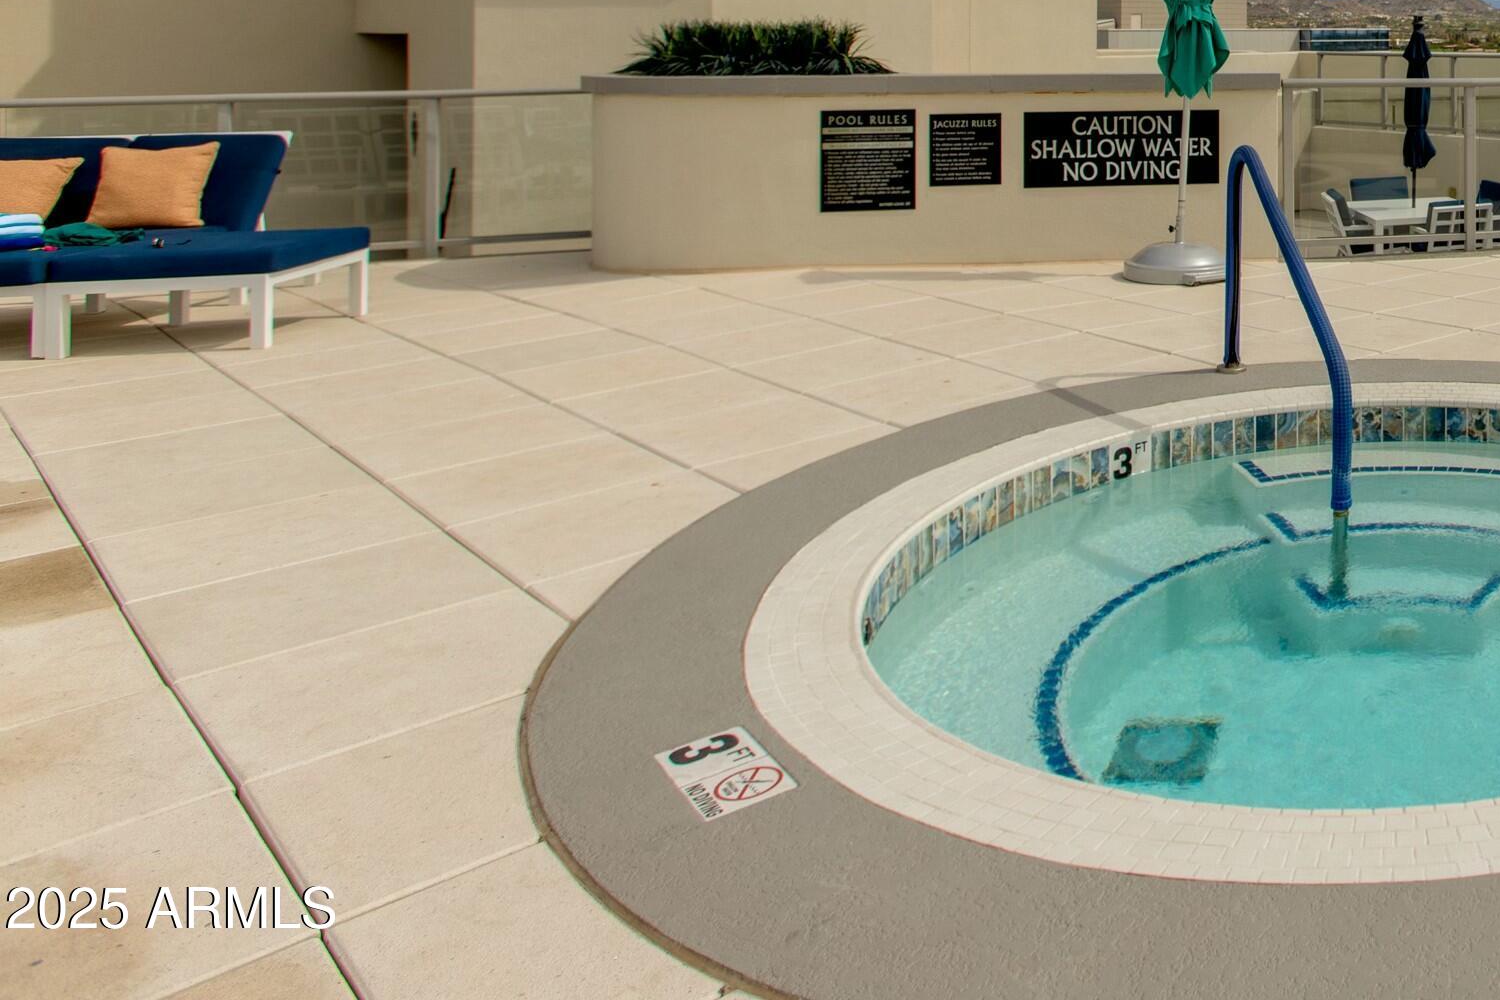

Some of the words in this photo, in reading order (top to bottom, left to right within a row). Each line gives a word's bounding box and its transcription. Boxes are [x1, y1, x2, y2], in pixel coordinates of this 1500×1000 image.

[828, 115, 864, 126] POOL
[869, 114, 908, 125] RULES
[933, 120, 969, 130] JACUZZI
[971, 119, 997, 128] RULES
[1071, 115, 1173, 136] CAUTION
[1031, 138, 1135, 159] SHALLOW
[1062, 161, 1098, 182] NO
[1105, 160, 1180, 180] DIVING
[1113, 446, 1132, 480] 3
[1135, 441, 1147, 454] FT
[668, 733, 739, 765] 3
[727, 747, 756, 762] FT
[684, 783, 706, 796] NO
[692, 792, 723, 818] DIVING
